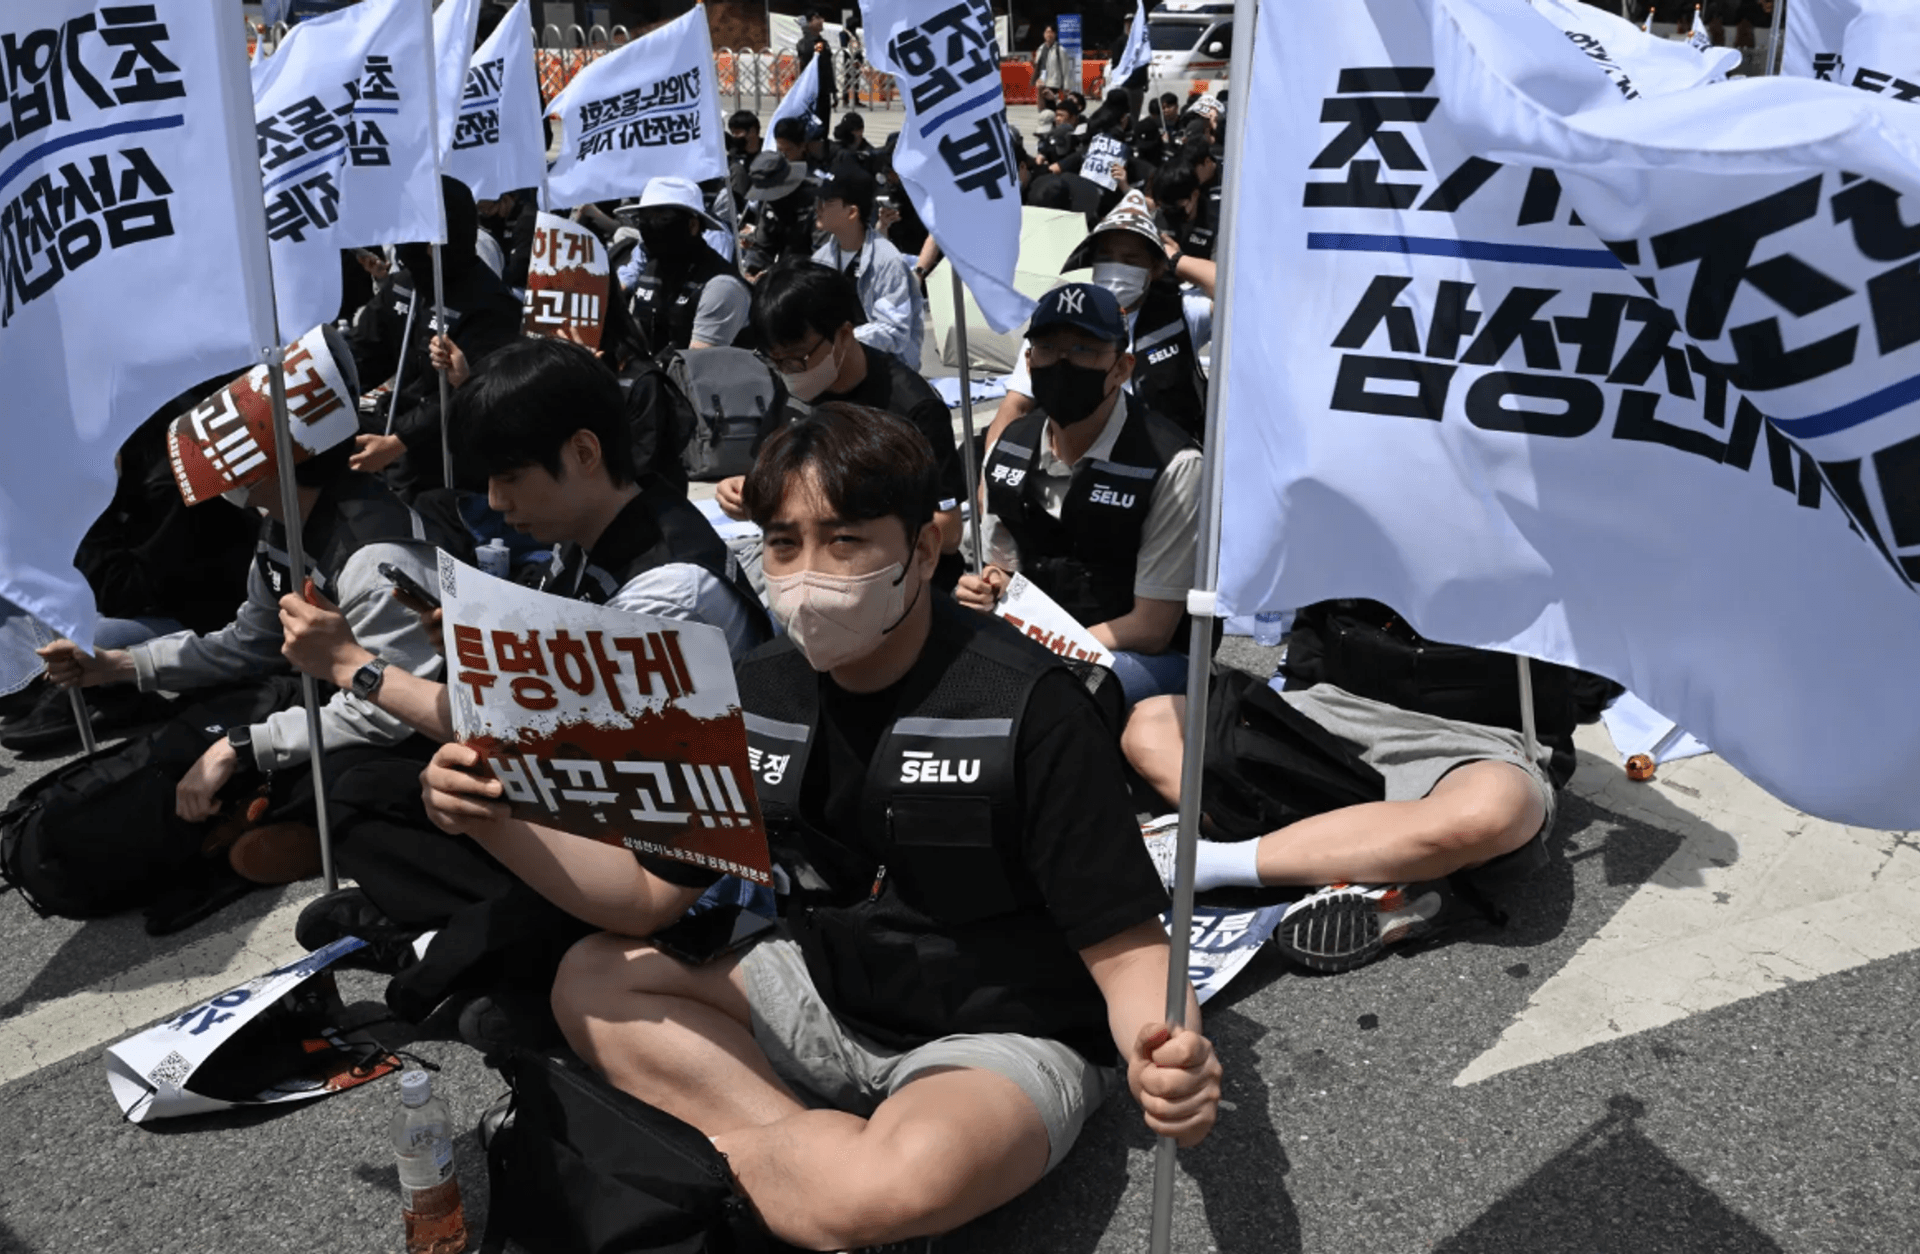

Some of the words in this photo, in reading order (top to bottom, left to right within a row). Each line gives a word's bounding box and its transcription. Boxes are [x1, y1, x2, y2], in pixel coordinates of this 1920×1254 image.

[1148, 345, 1180, 366] SELU
[1089, 486, 1136, 509] SELU
[453, 624, 697, 711] 투명하게
[900, 755, 981, 783] SELU
[487, 753, 752, 828] 바꾸고!!!
